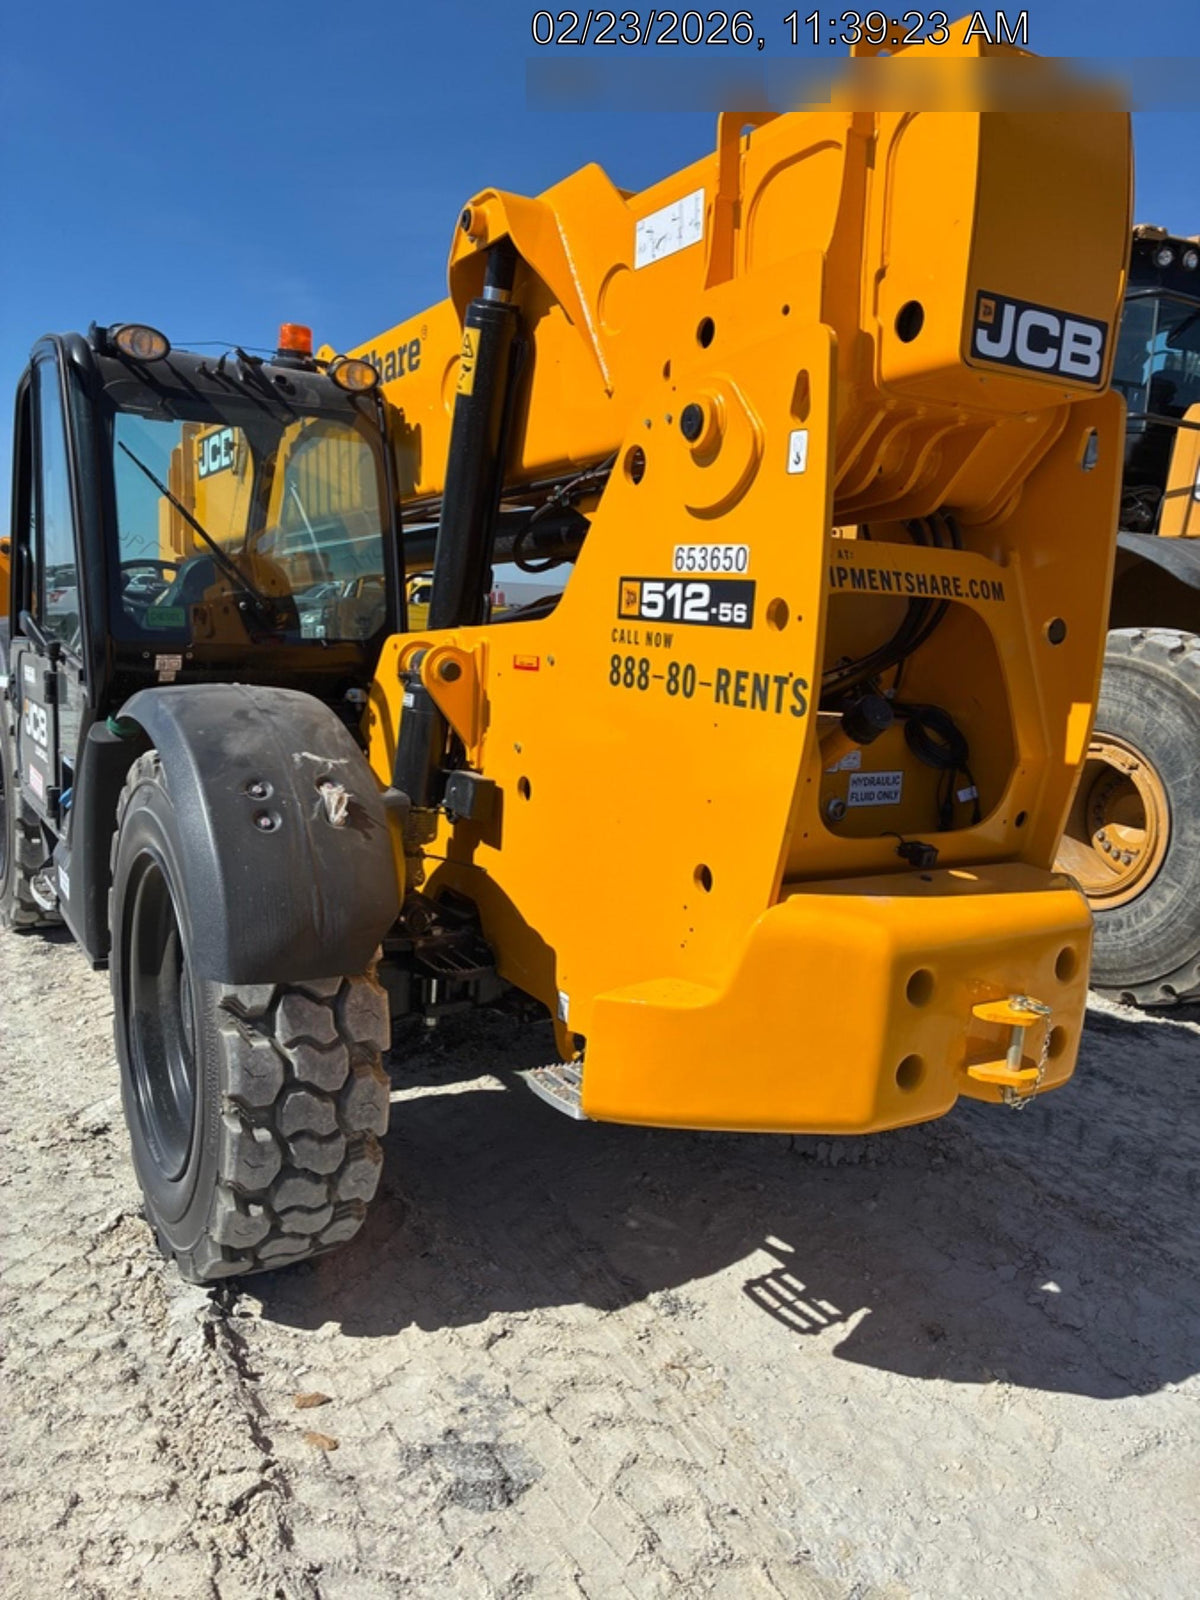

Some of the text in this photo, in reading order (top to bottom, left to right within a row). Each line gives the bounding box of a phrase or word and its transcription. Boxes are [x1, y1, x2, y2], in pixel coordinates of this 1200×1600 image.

[976, 303, 1103, 378] JCB
[360, 337, 421, 386] hare
[674, 546, 748, 572] 653650
[611, 628, 674, 649] CALL NOW
[609, 653, 809, 717] 888-80-RENTS
[851, 775, 900, 787] HYDRAULIC
[850, 790, 898, 802] FLUID ONLY
